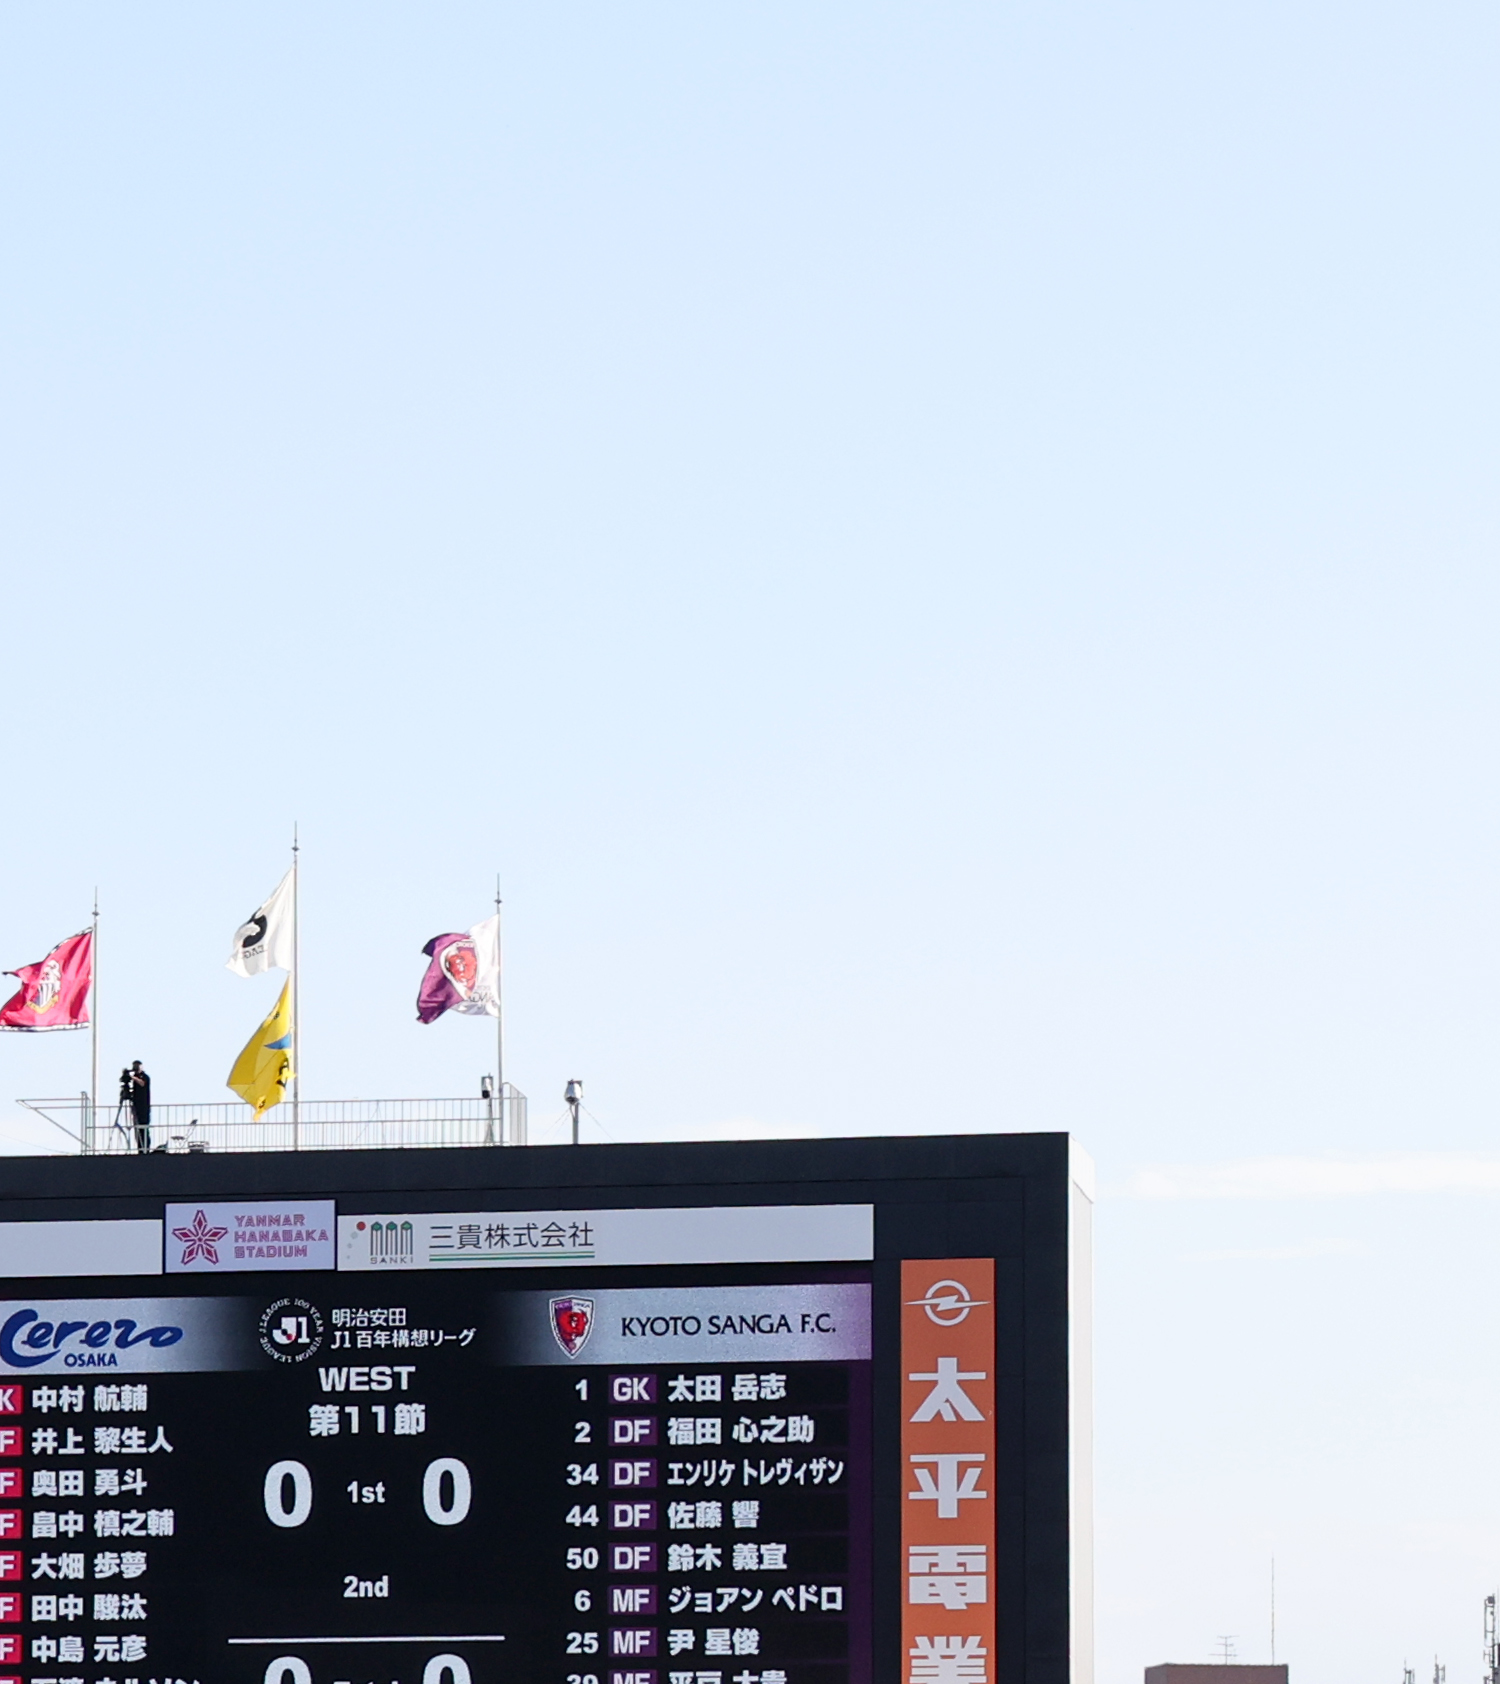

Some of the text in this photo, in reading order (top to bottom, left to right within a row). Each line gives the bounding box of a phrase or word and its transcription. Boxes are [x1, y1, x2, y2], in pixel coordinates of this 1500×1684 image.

[234, 1214, 305, 1228] YANMAR
[234, 1229, 329, 1243] HANASAKA
[429, 1221, 594, 1250] 三貴株式会社
[234, 1245, 308, 1259] STADIUM
[370, 1255, 414, 1265] SANKI
[332, 1308, 407, 1328] 明治安田
[621, 1312, 837, 1337] KYOTO SANGA F.C.
[64, 1353, 118, 1367] OSAKA
[319, 1366, 416, 1392] WEST
[575, 1372, 787, 1402] 1 GK 太田 岳志
[32, 1384, 85, 1414] 中村
[93, 1383, 148, 1412] 航輔
[308, 1404, 426, 1437] 第11節
[574, 1414, 815, 1446] 2 DF 福田 心之助
[31, 1427, 85, 1455] 井上
[31, 1469, 84, 1497] 奥田
[94, 1467, 148, 1496] 勇斗
[566, 1456, 844, 1487] 34 DF エンリケ トレヴィザン
[263, 1457, 472, 1528] 0 1st 0
[32, 1509, 84, 1539] 畠中
[565, 1500, 760, 1530] 44 DF 佐藤 響
[31, 1552, 85, 1580] 大畑
[93, 1550, 147, 1579] 歩夢
[566, 1547, 599, 1570] 50
[614, 1546, 651, 1570] DF
[667, 1542, 722, 1572] 鈴木
[343, 1575, 389, 1598] 2nd
[574, 1584, 843, 1614] 6 MF ジョアン ペドロ
[31, 1593, 84, 1622] 田中
[93, 1592, 148, 1621] 駿汰
[31, 1635, 85, 1664] 中島
[93, 1634, 148, 1663] 元彦
[565, 1627, 760, 1656] 25 MF 尹 星俊
